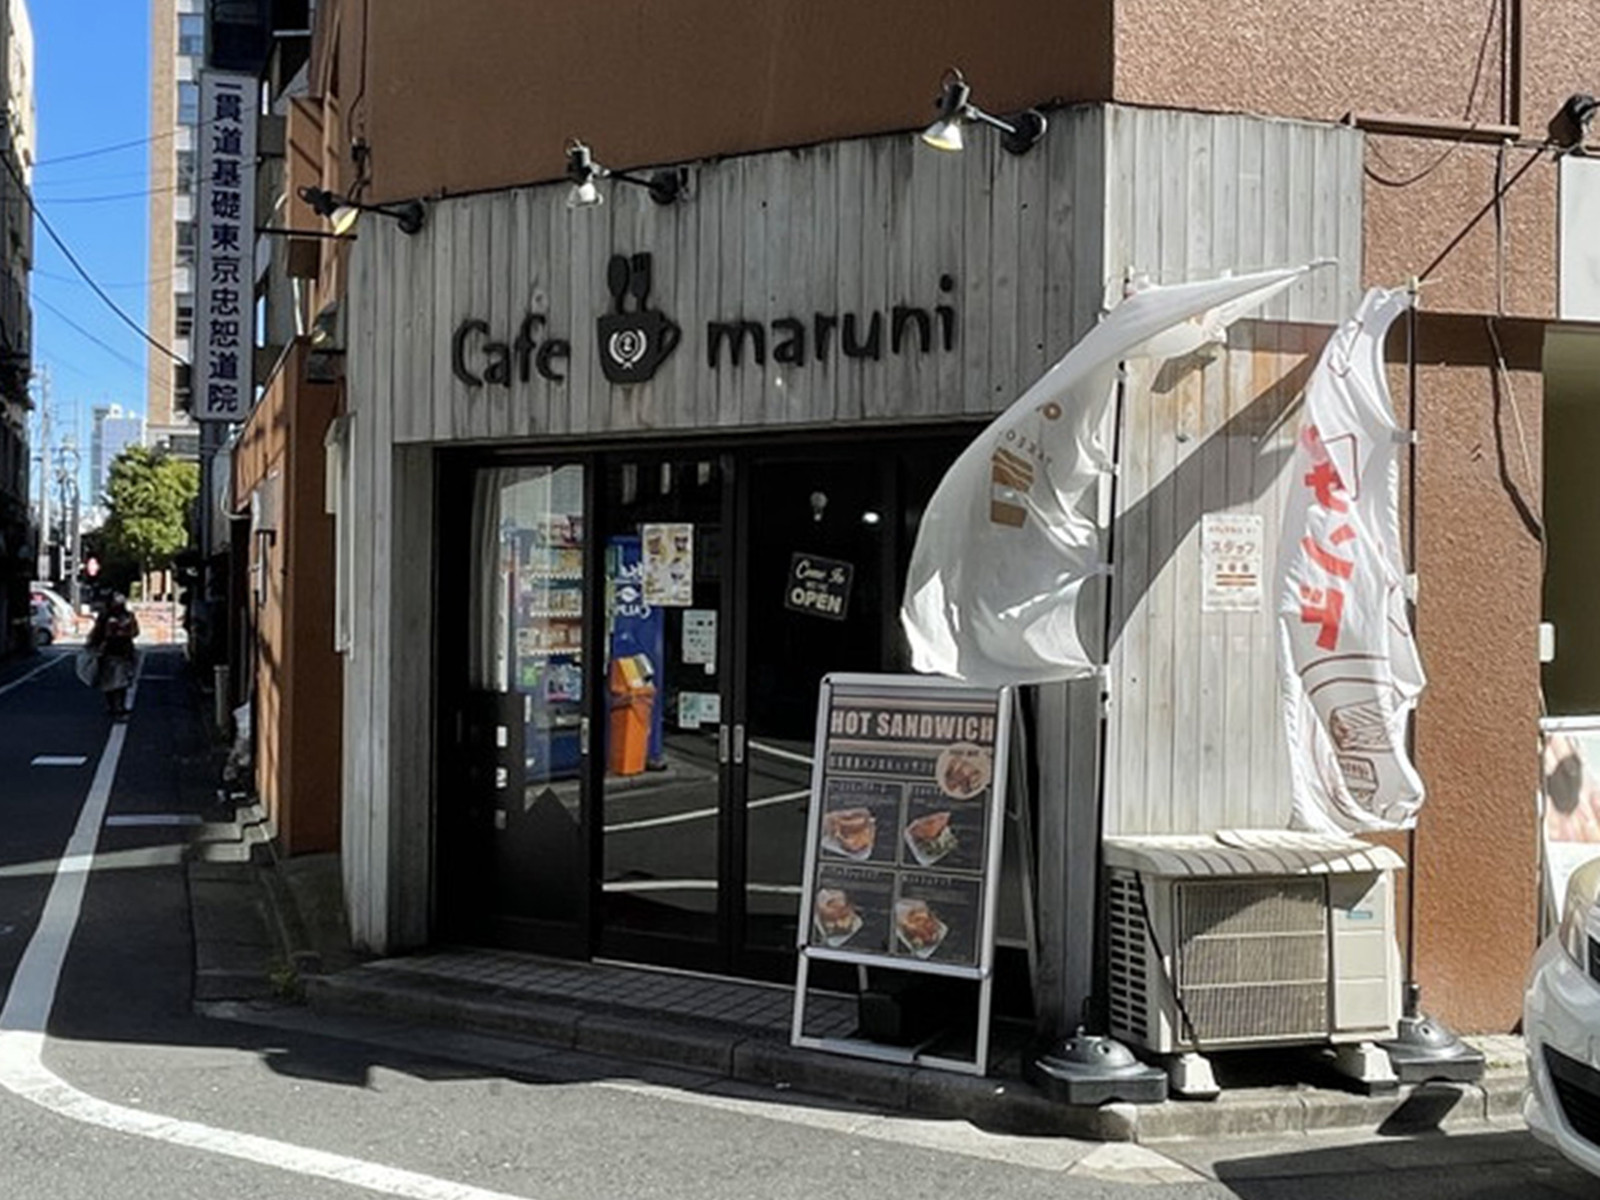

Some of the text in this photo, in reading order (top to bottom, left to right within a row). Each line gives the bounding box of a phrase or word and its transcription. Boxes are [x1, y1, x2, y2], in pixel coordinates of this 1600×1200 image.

[207, 82, 243, 414] 一貫道基礎東京忠恕道院
[452, 274, 955, 388] Cafe maruni
[791, 587, 842, 613] OPEN
[831, 710, 994, 742] HOT SANDWICH
